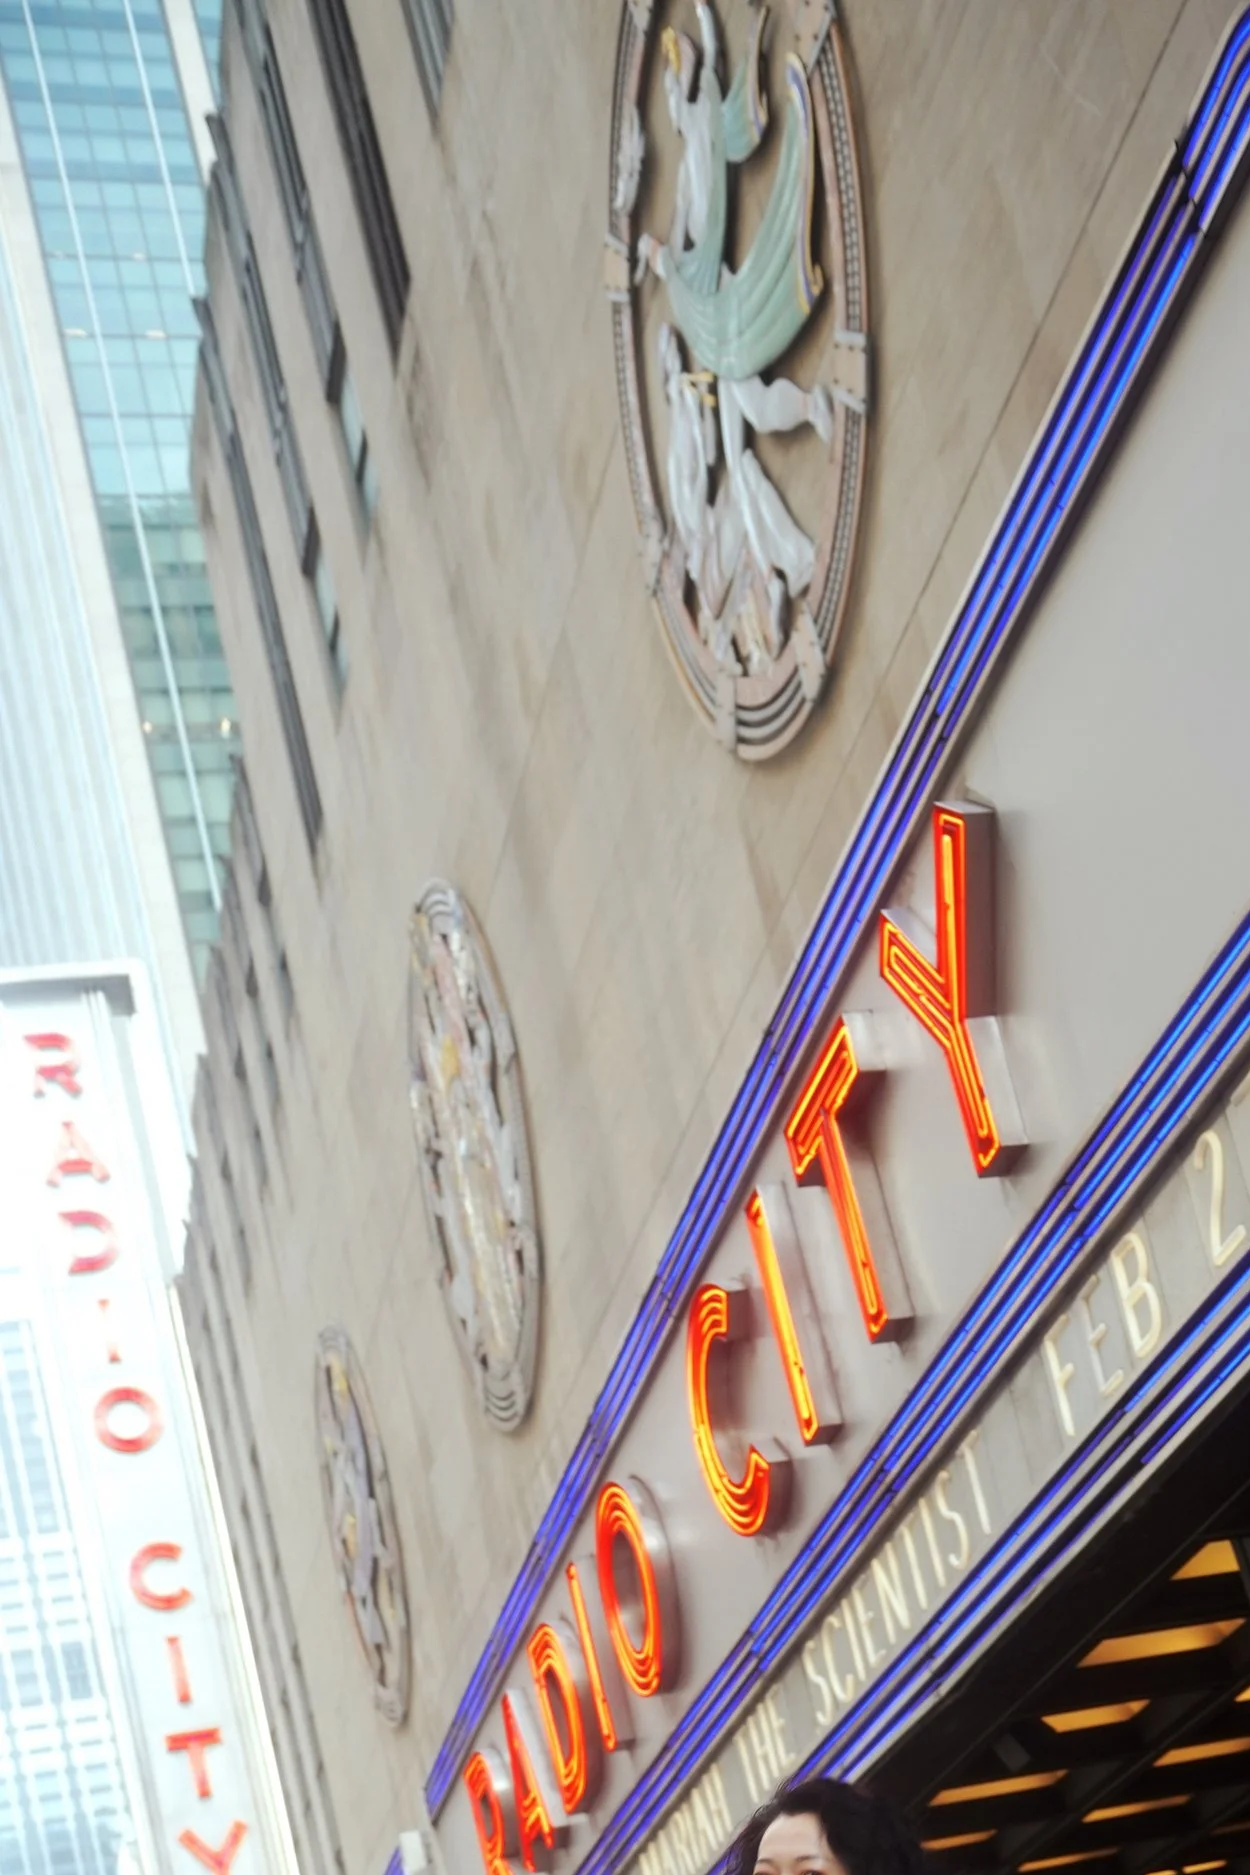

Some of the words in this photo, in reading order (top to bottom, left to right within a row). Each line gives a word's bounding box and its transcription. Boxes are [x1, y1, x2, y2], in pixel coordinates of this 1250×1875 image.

[22, 1031, 164, 1454] RADIO
[686, 802, 1010, 1537] CITY
[732, 1684, 797, 1804] THE
[803, 1430, 992, 1727] SCIENTIST
[1043, 1231, 1163, 1437] FEB
